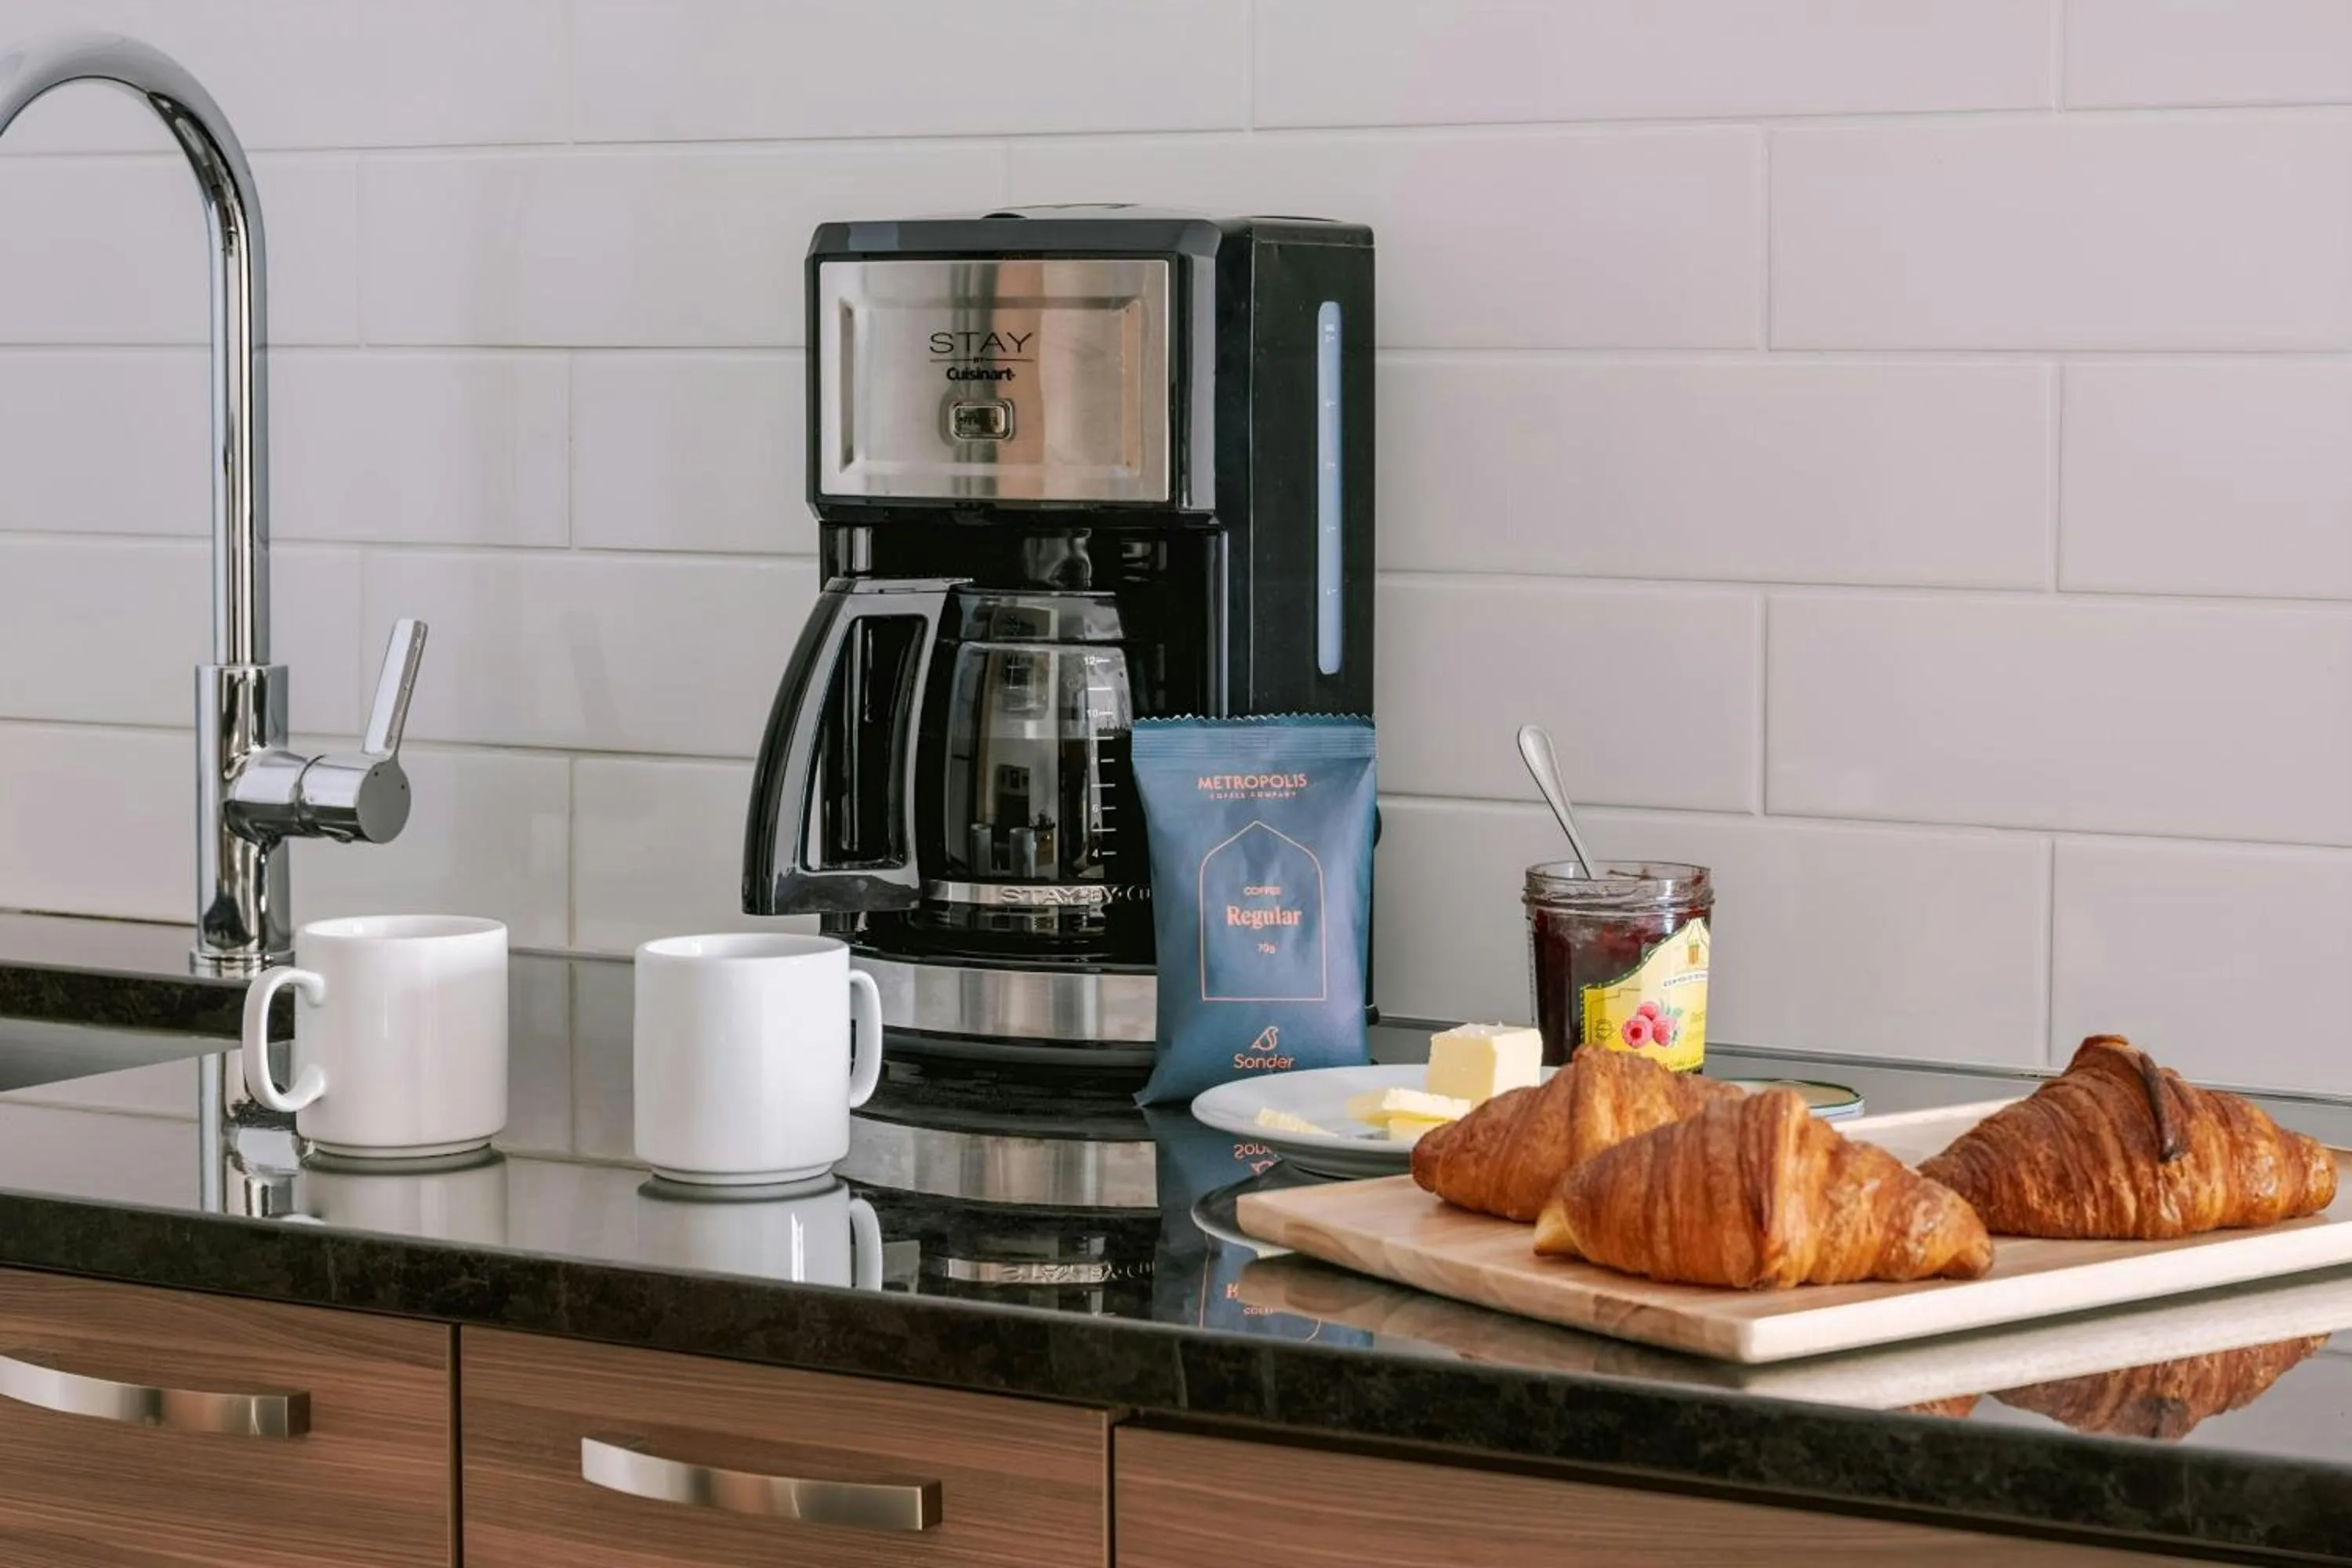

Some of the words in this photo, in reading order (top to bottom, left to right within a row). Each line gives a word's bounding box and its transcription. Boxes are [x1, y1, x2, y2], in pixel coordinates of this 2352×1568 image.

[930, 332, 1033, 353] STAY
[946, 366, 1013, 380] Cuisinart
[1084, 656, 1096, 666] 12
[1087, 709, 1098, 717] 10
[1197, 773, 1308, 791] METROPOLIS
[1092, 848, 1098, 858] 4
[1002, 886, 1077, 905] STAY
[1226, 905, 1302, 929] Regular
[1232, 1052, 1296, 1069] Sonder
